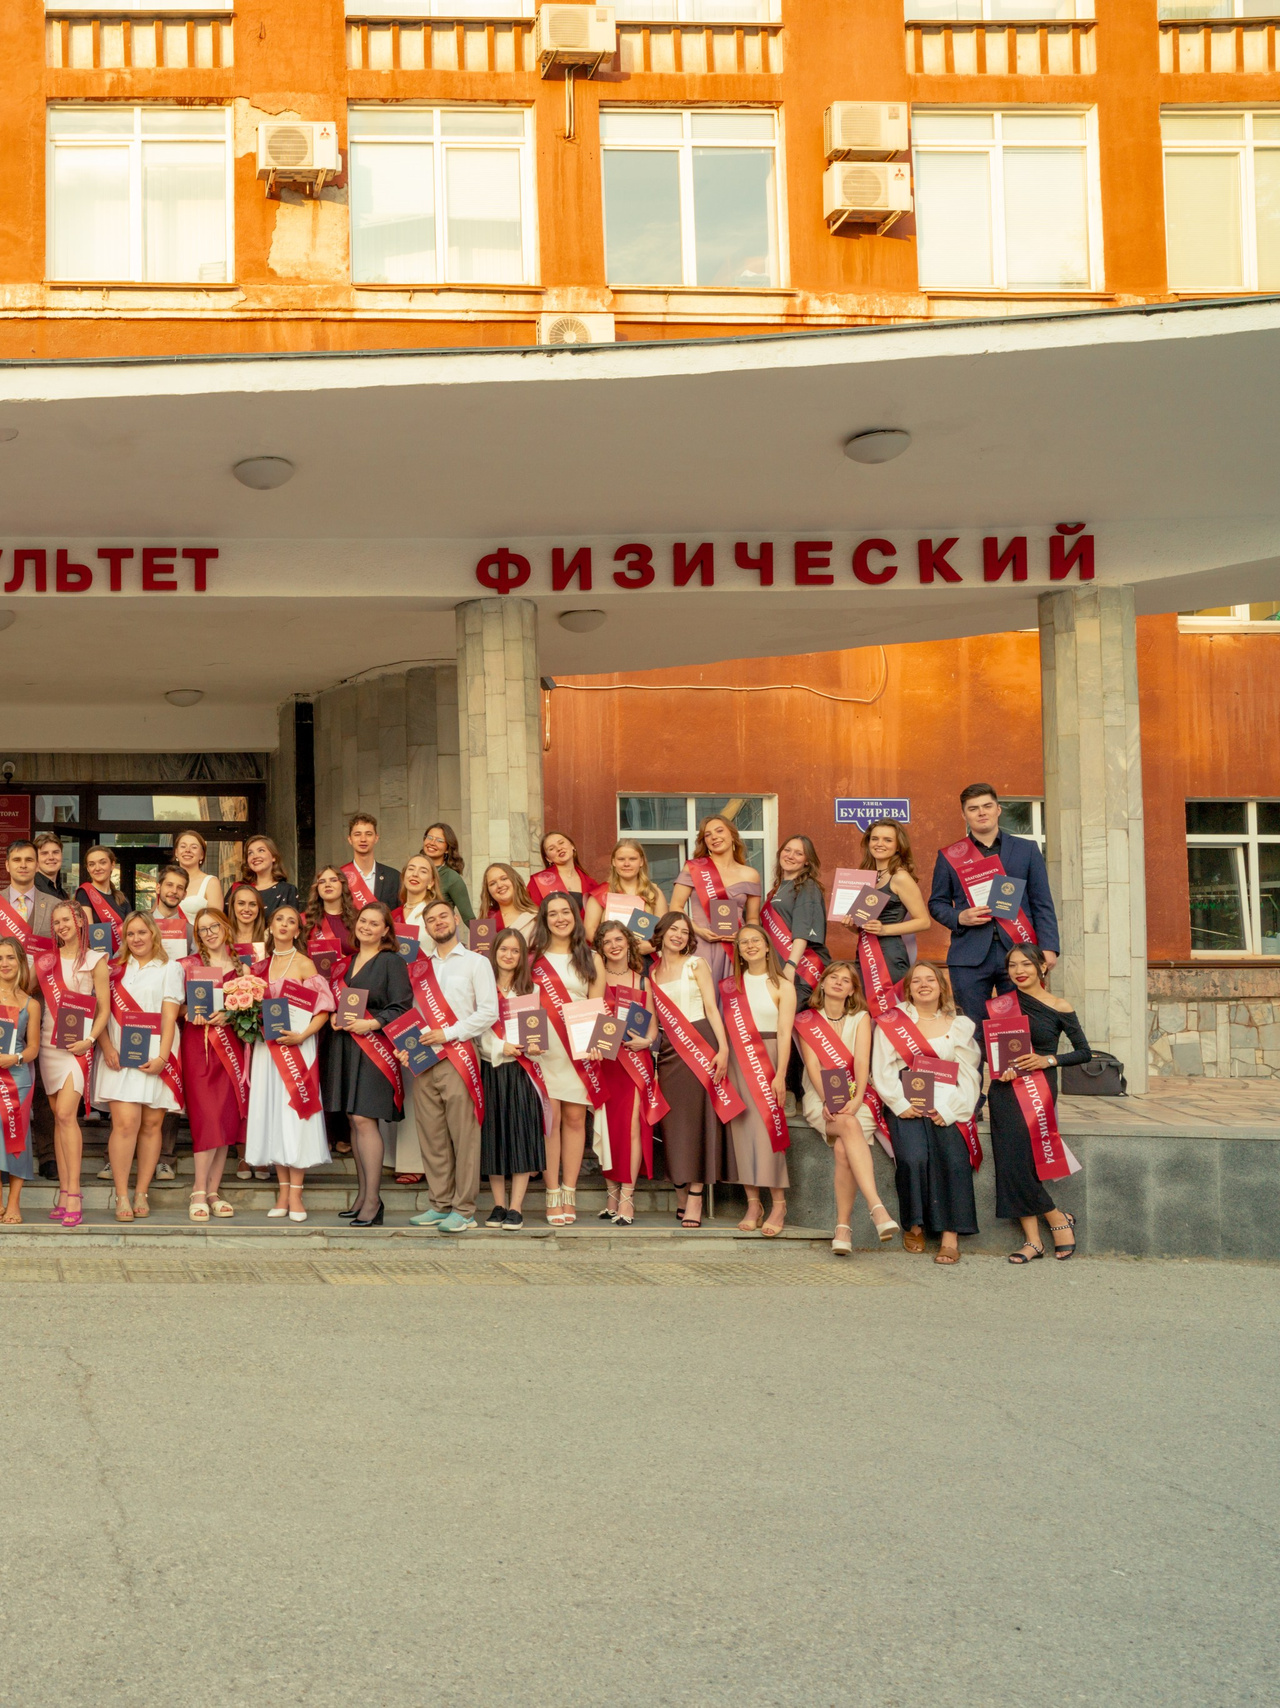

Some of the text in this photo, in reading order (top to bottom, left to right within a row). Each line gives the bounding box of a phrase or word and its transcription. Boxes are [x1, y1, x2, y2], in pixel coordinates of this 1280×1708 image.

[475, 523, 1095, 594] ФИЗИЧЕСКИЙ
[840, 808, 907, 818] БУКИРЕВА
[701, 870, 718, 900] ЛУЧШ
[46, 974, 61, 1005] ЛУЧШ
[109, 980, 129, 1012] ЛУЧШИ
[420, 979, 445, 1024] ЛУЧШИЙ
[875, 992, 888, 1013] 202
[214, 1026, 243, 1081] ЫПУСКНИК
[364, 1030, 398, 1077] ПУСКНИК
[810, 1026, 847, 1069] ЛУЧШИЙ
[730, 997, 782, 1137] ЛУЧШИЙ ВЫПУСКНИК 2024
[295, 1076, 310, 1104] 2024
[588, 1073, 601, 1094] 2024
[647, 1085, 658, 1109] 2024
[714, 1082, 731, 1106] 2024
[8, 1114, 17, 1139] 2024
[1041, 1139, 1055, 1165] 2024
